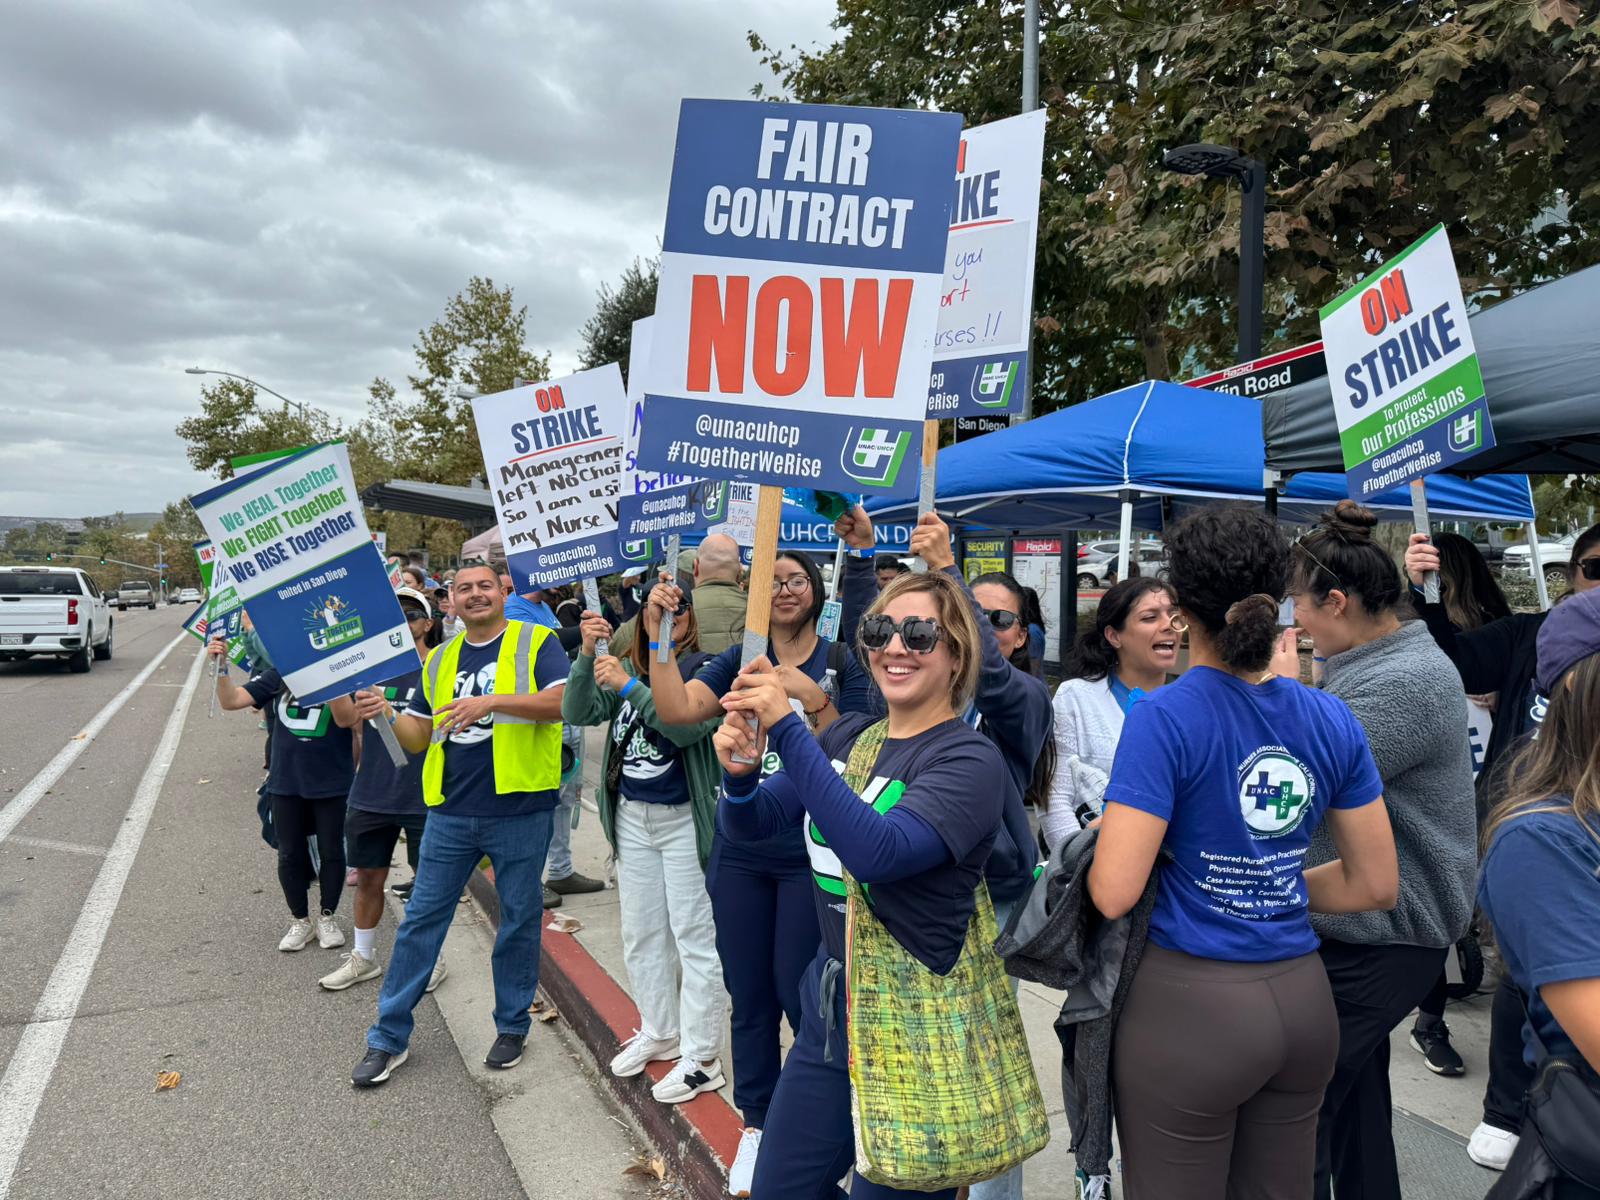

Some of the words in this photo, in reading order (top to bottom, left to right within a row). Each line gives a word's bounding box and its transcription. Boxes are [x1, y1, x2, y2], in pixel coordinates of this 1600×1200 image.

[757, 118, 873, 186] FAIR
[703, 185, 914, 249] CONTRACT
[953, 248, 983, 281] you
[1360, 267, 1413, 336] ON
[686, 274, 914, 398] NOW
[1344, 301, 1462, 409] STRIKE
[1244, 366, 1291, 395] Road
[535, 384, 566, 413] ON
[1383, 409, 1393, 421] To
[1394, 387, 1428, 416] Protect
[511, 404, 603, 454] STRIKE
[695, 414, 800, 447] @unacuhcp
[958, 418, 977, 430] San
[1361, 431, 1383, 456] Our
[1384, 385, 1466, 444] Professions
[500, 443, 623, 485] Managemen
[667, 440, 822, 478] #TogetherWeRise
[1372, 439, 1424, 472] @unacuhcp
[1362, 451, 1442, 494] #TogetherWeRise
[219, 512, 244, 533] We
[241, 493, 277, 522] HEAL
[274, 462, 339, 506] Together
[497, 480, 540, 506] left
[642, 494, 687, 515] @unacuhcp
[221, 537, 248, 559] We
[244, 516, 283, 546] FIGHT
[281, 485, 347, 529] Together
[503, 509, 527, 524] So
[536, 501, 545, 514] I
[548, 496, 581, 511] am
[630, 511, 696, 534] #TogetherWeRise
[228, 561, 256, 584] We
[254, 539, 289, 571] RISE
[288, 510, 357, 552] Together
[508, 528, 541, 548] my
[545, 515, 604, 538] Nurse
[967, 541, 1005, 552] SECURITY
[1025, 543, 1052, 551] Rapid
[528, 556, 614, 586] #TogetherWeRise
[538, 544, 596, 567] @unacuhcp
[277, 582, 301, 600] United
[302, 579, 308, 589] in
[309, 574, 326, 587] San
[326, 566, 348, 581] Diego
[328, 651, 366, 672] @unacuhcp
[1251, 787, 1275, 795] UNAC
[1200, 851, 1240, 863] Registered
[1208, 864, 1244, 874] Physician
[1205, 876, 1223, 884] Case
[1224, 878, 1258, 886] Managers
